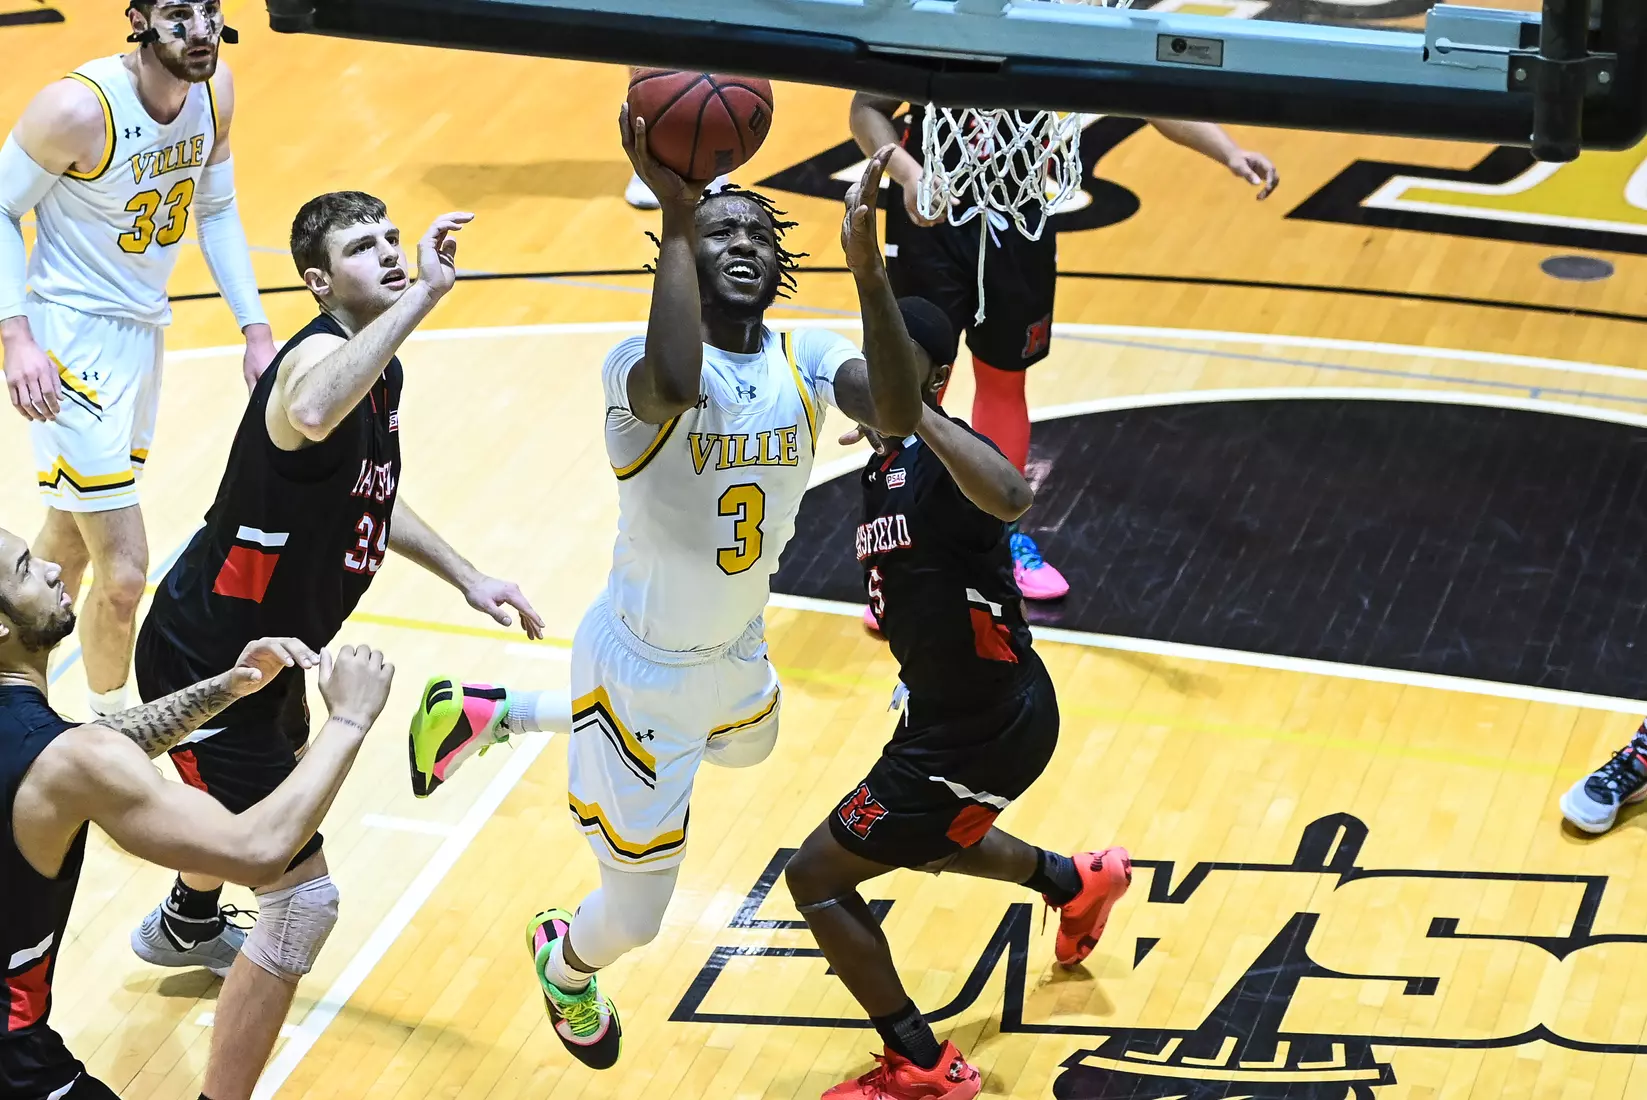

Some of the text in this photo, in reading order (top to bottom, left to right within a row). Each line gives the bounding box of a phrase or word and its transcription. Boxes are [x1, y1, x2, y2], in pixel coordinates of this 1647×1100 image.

[128, 133, 205, 185] VILLE
[117, 177, 195, 254] 33
[687, 424, 799, 475] VILLE
[716, 482, 765, 576] 3
[837, 782, 889, 841] M
